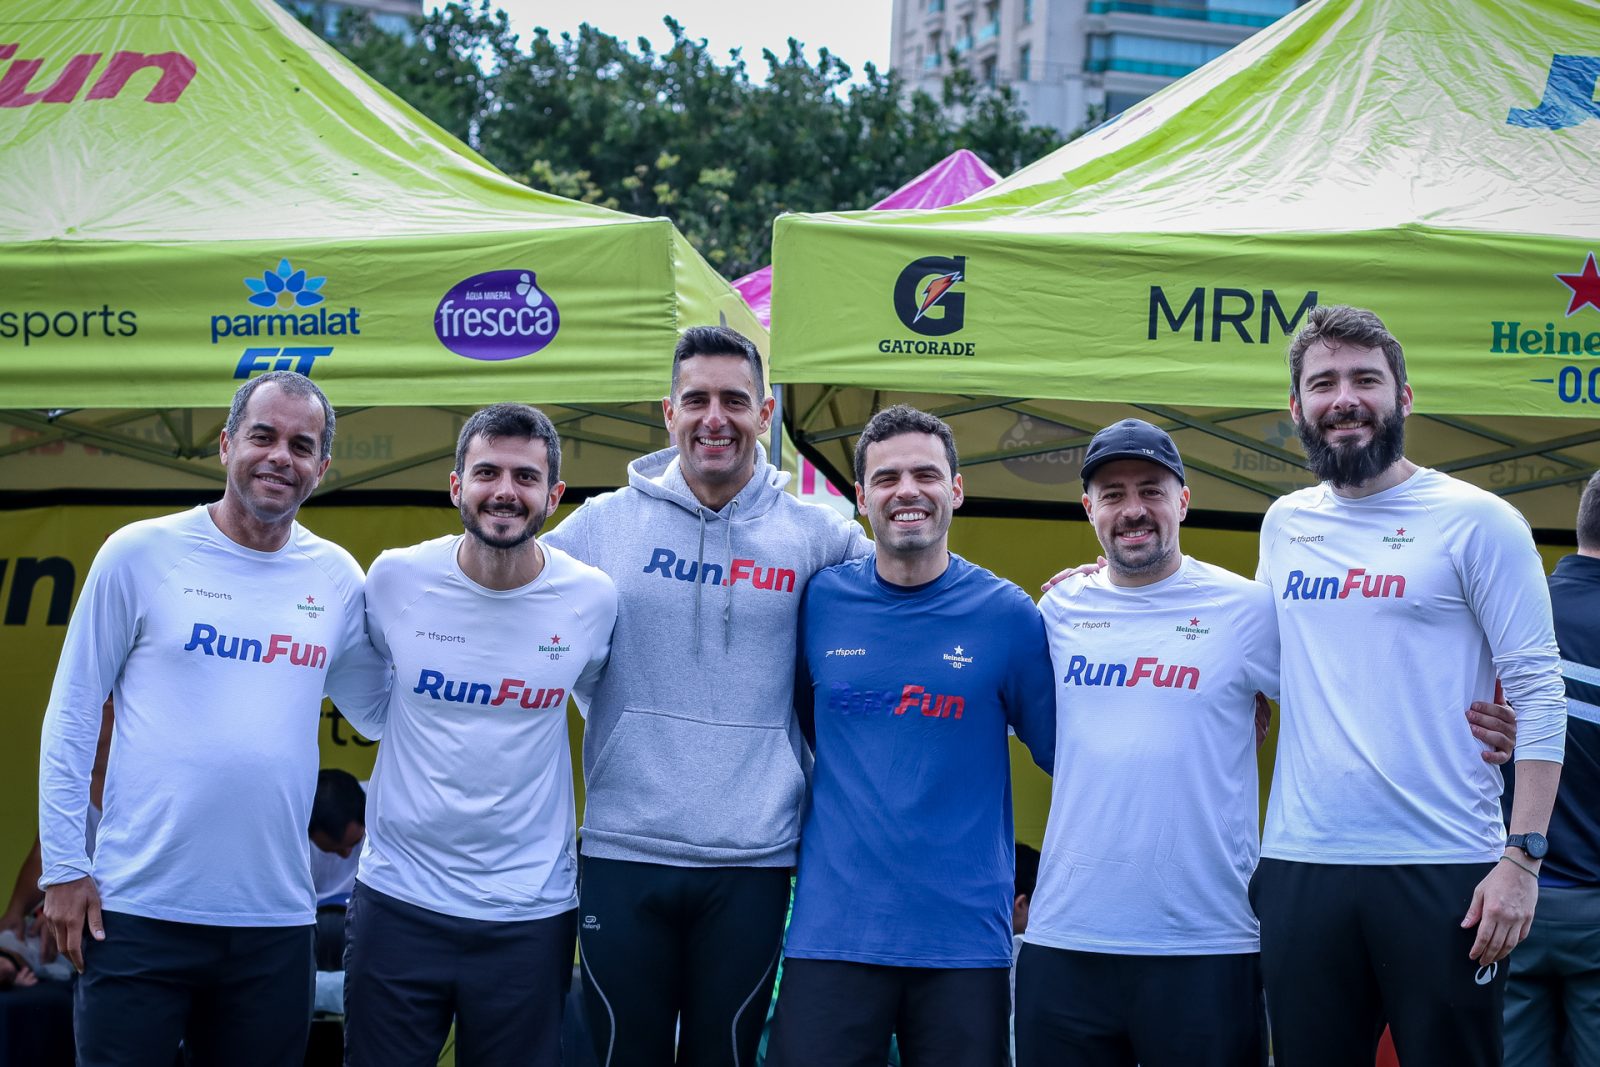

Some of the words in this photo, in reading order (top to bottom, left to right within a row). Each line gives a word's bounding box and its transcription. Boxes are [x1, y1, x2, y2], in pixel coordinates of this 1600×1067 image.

[0, 304, 137, 346] sports
[211, 307, 361, 344] parmalat
[440, 300, 553, 337] frescca
[1148, 286, 1318, 344] MRM
[878, 340, 976, 356] GATORADE
[1297, 534, 1325, 543] tfsports
[196, 588, 232, 600] tfsports
[1283, 568, 1406, 600] RunFun
[1082, 620, 1111, 629] tfsports
[1175, 625, 1210, 634] Heineken
[184, 623, 327, 669] RunFun
[428, 631, 466, 643] tfsports
[835, 647, 866, 657] tfsports
[943, 653, 973, 663] Heineken
[1063, 655, 1200, 690] RunFun
[413, 669, 565, 709] RunFun
